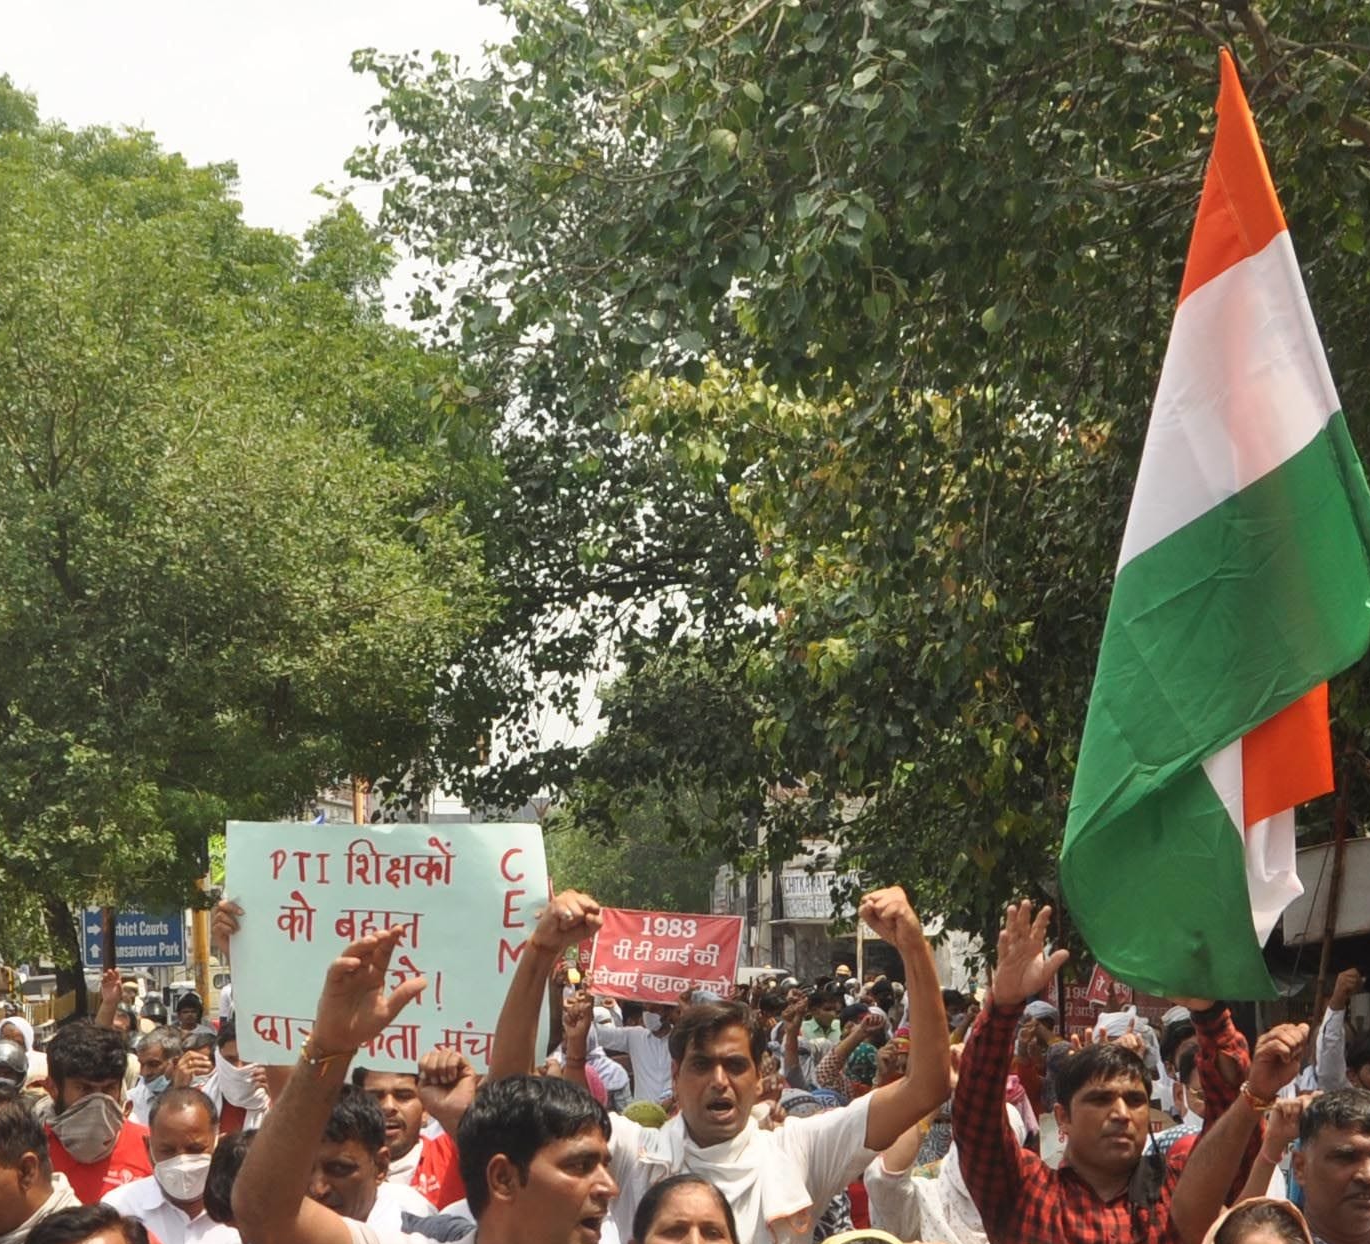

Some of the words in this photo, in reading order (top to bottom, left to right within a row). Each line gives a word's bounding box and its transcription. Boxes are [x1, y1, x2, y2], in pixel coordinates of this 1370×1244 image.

[269, 848, 331, 885] PTI
[345, 836, 457, 889] शिक्षकों
[139, 921, 169, 936] Courts
[277, 890, 317, 942] को
[640, 915, 698, 939] 1983
[158, 942, 180, 956] Park
[613, 939, 632, 961] पी
[633, 940, 654, 962] टी
[654, 942, 693, 967] आई
[693, 943, 720, 968] की
[593, 965, 640, 993] सेवाएं
[641, 971, 691, 993] बहाल
[434, 1020, 496, 1066] मंच
